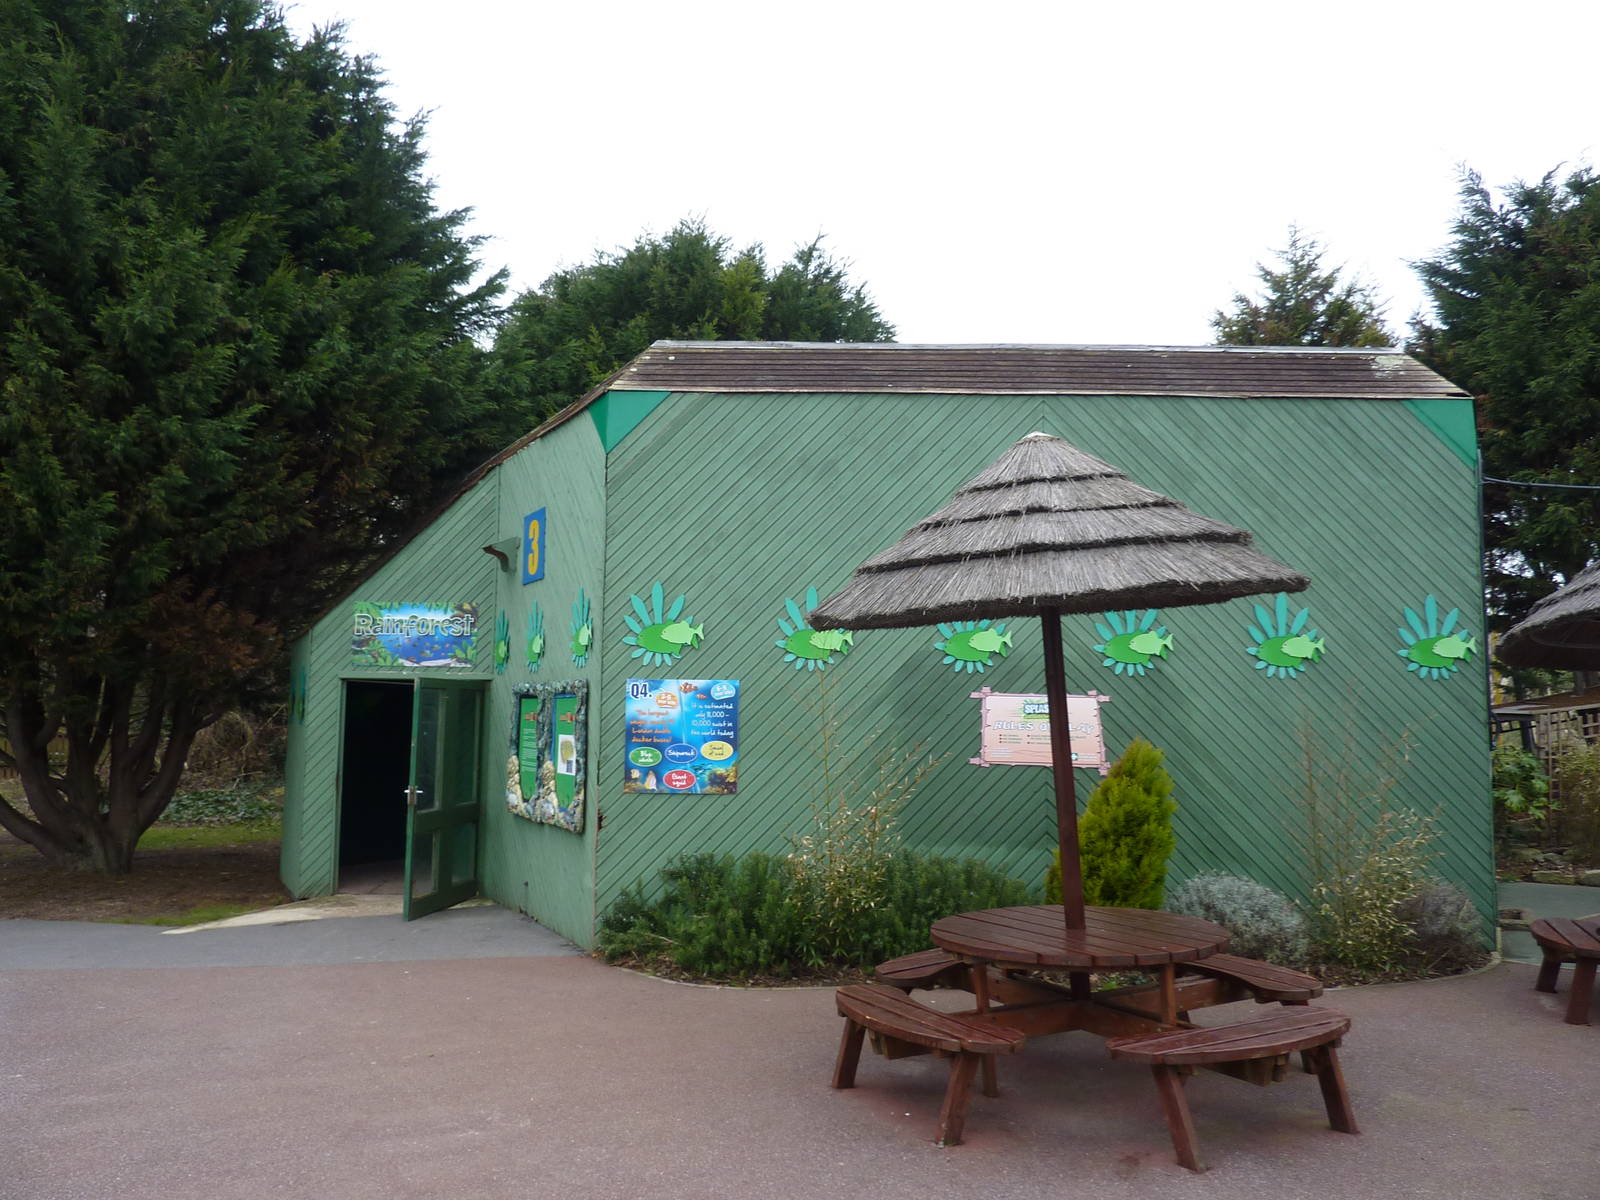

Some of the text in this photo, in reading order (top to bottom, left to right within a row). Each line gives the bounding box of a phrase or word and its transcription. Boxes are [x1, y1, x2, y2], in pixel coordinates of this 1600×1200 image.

[528, 519, 540, 576] 3
[354, 613, 474, 637] Rainforest
[631, 683, 652, 699] Q4.
[1025, 703, 1050, 714] SPLAS
[717, 729, 734, 738] today
[993, 720, 1034, 731] RULES
[1068, 722, 1095, 735] LAY
